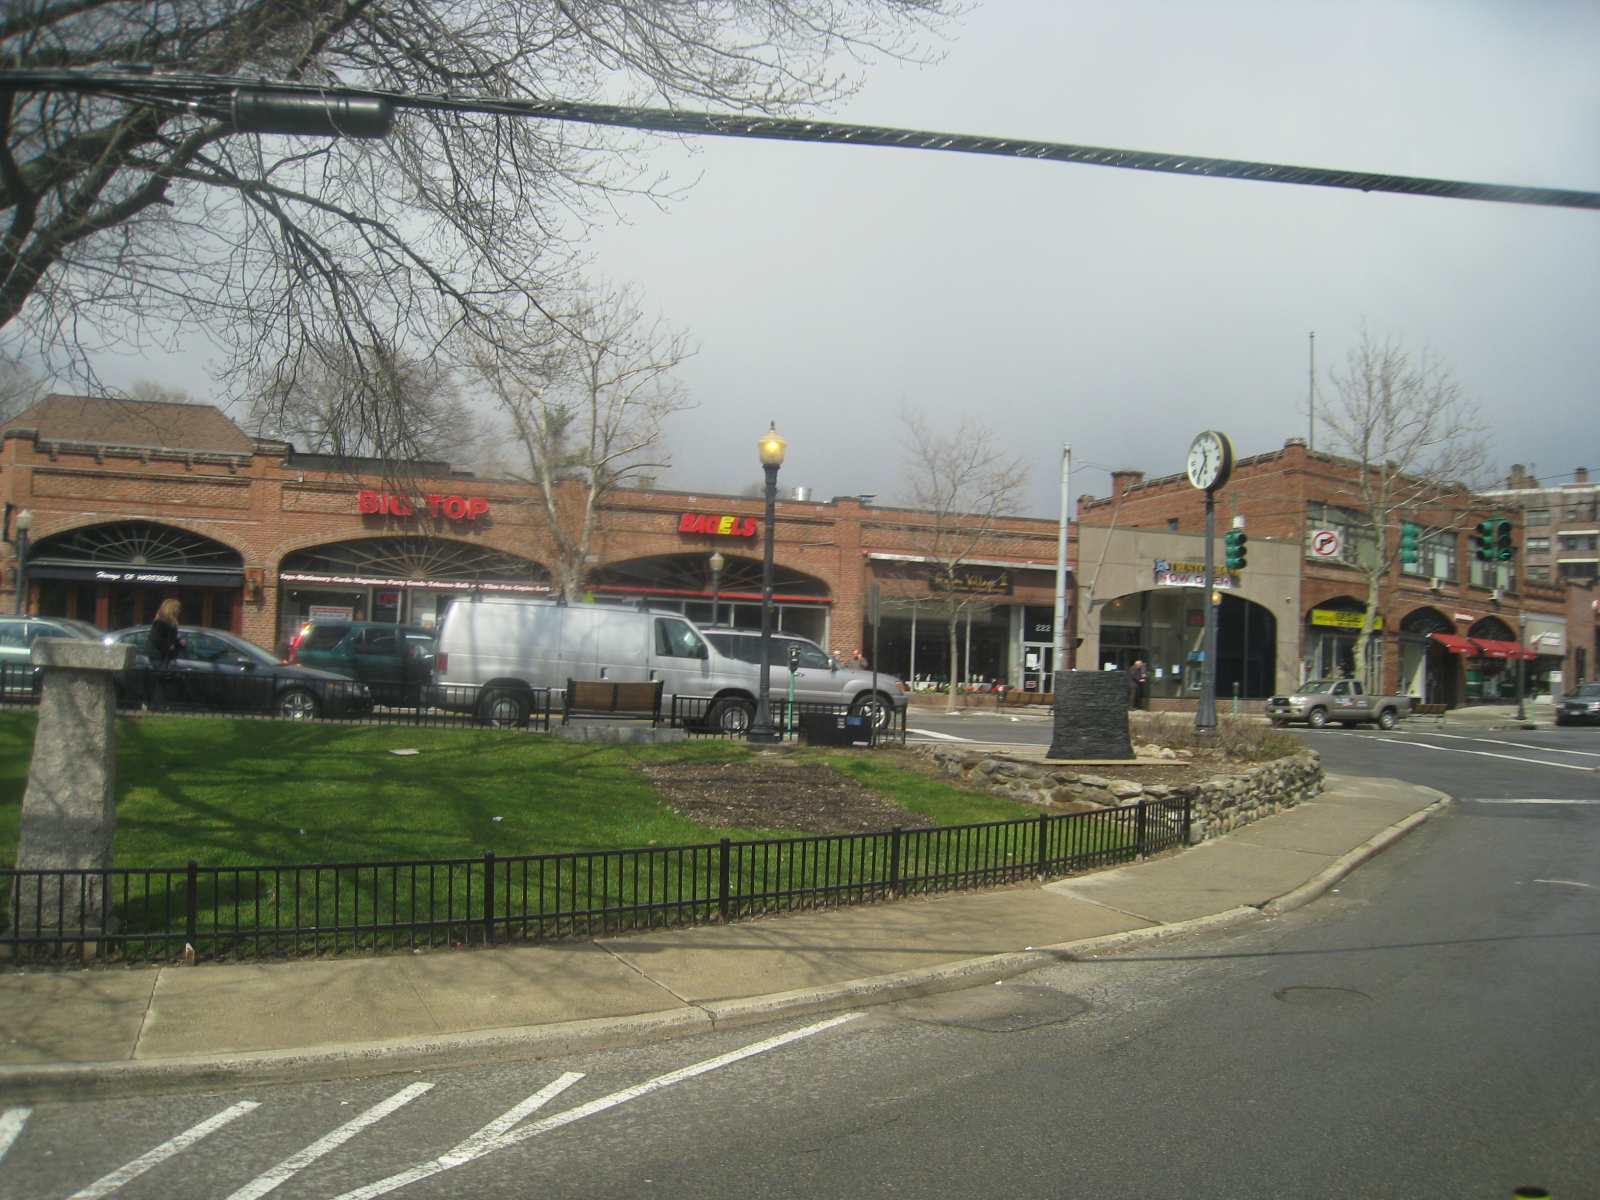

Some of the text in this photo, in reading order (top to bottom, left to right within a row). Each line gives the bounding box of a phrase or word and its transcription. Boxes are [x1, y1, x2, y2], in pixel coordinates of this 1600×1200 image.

[358, 491, 489, 520] BIG TOP
[679, 513, 757, 537] BAGELS
[1159, 573, 1229, 585] NOW OEN
[1035, 624, 1052, 632] 222
